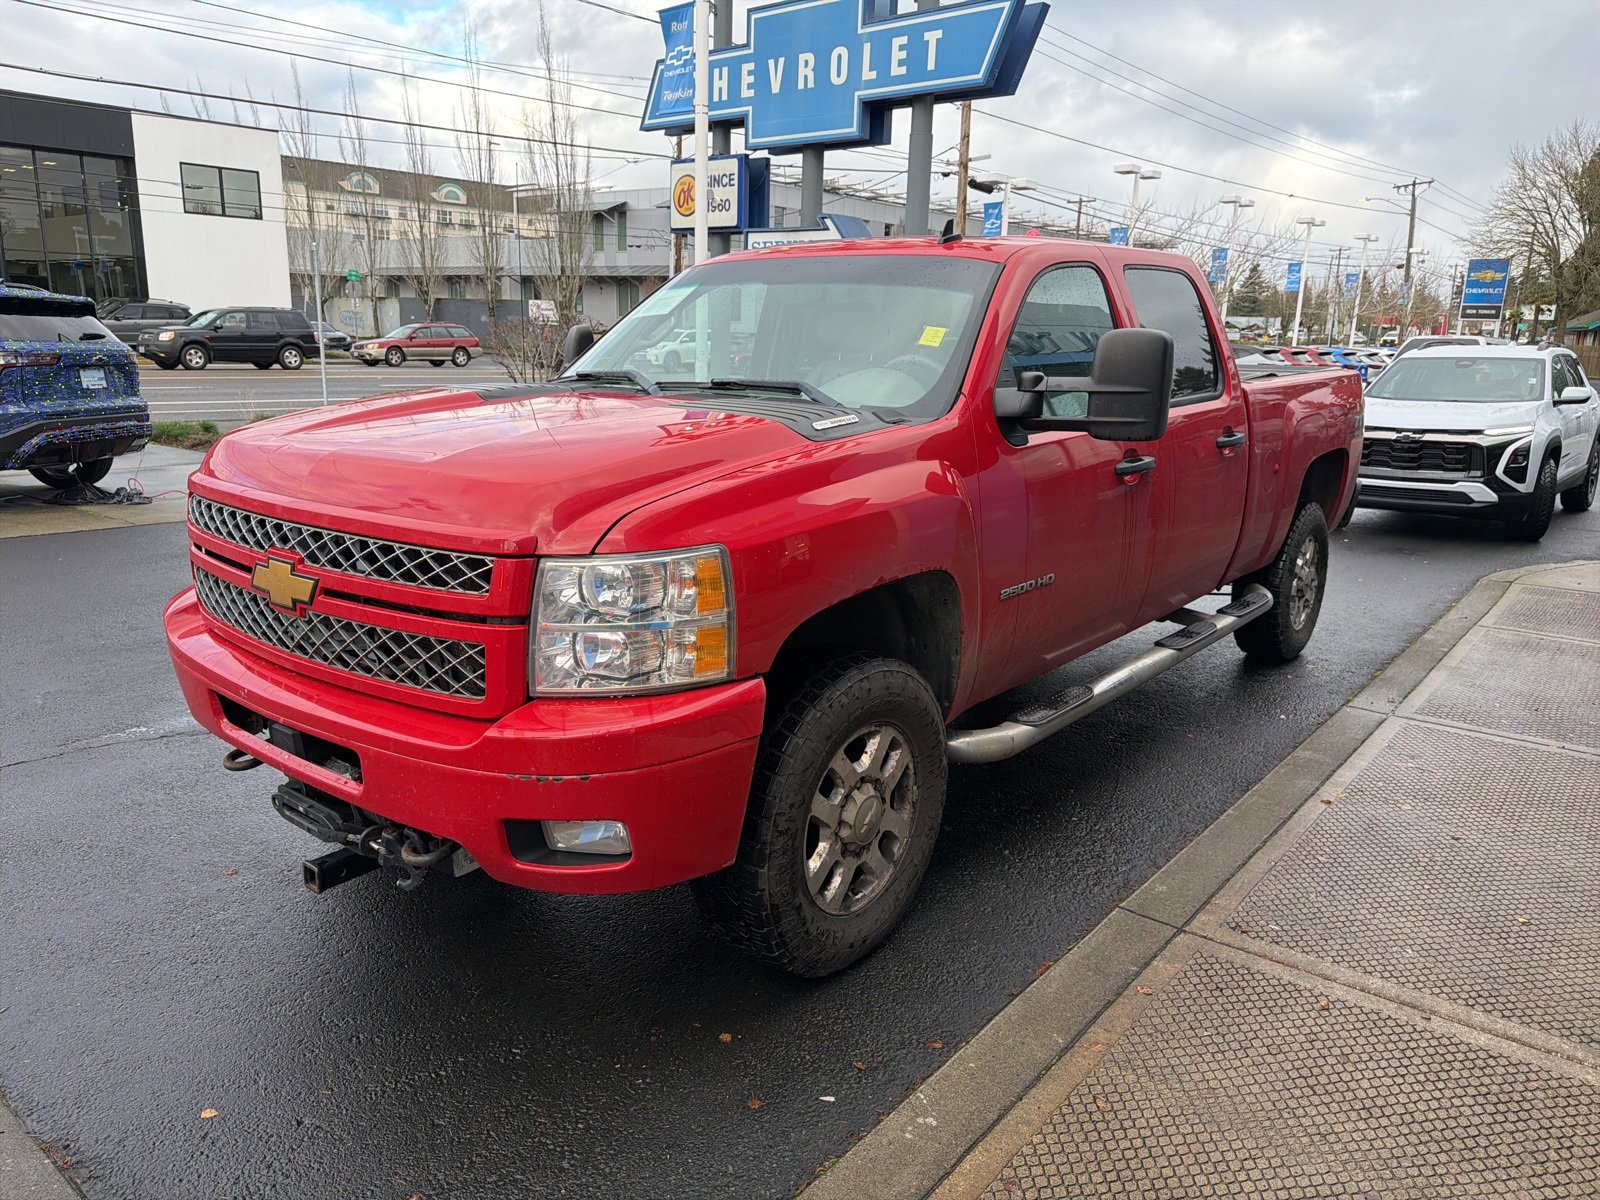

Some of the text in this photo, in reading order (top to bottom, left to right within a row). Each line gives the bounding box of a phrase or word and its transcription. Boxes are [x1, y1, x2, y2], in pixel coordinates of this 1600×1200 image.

[664, 65, 694, 78] CHEVROLET
[711, 29, 943, 102] HEVROLET
[663, 87, 693, 100] Tonkin
[707, 172, 736, 188] INCE
[1000, 573, 1055, 600] 2500 HD
